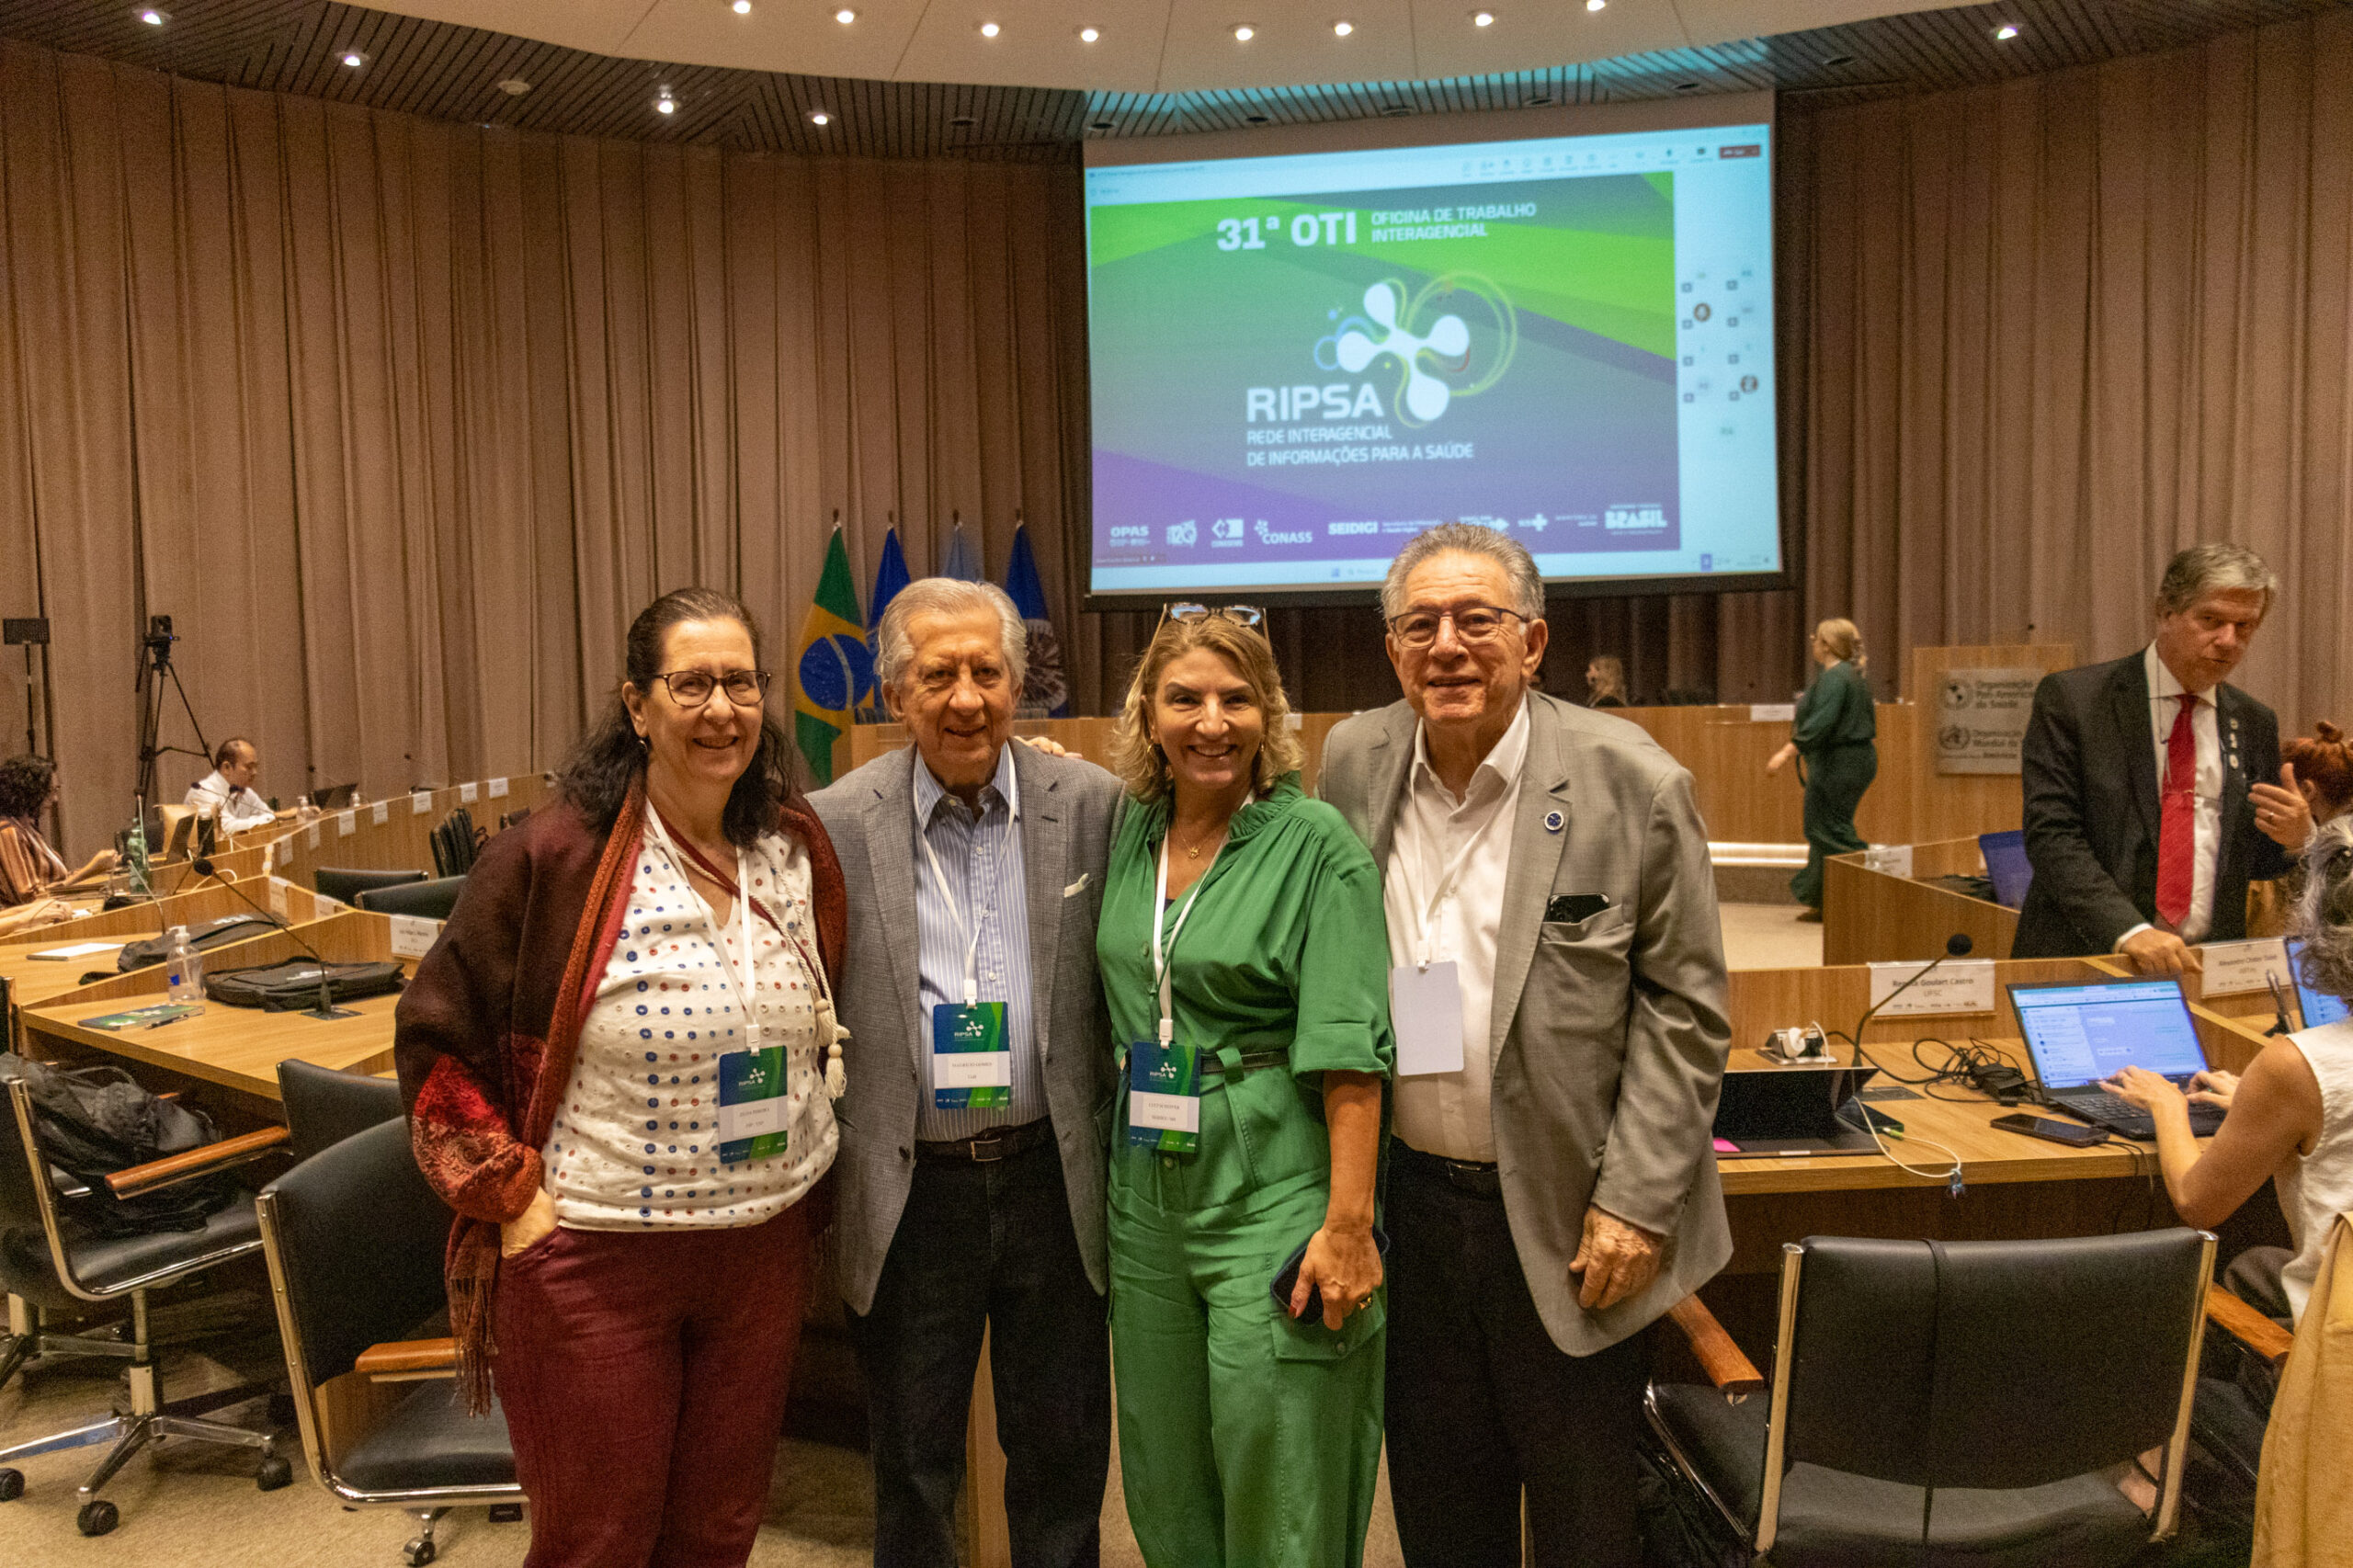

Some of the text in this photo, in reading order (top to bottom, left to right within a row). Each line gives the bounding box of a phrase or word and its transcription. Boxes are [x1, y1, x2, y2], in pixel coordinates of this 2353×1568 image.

[1371, 202, 1537, 226] OFICINA DE TRABALHO
[1217, 211, 1358, 251] 31ª OTI
[1371, 222, 1488, 243] INTERAGENCIAL
[1247, 382, 1384, 422] RIPSA
[1247, 425, 1392, 445] REDE INTERAGENCIAL
[1247, 441, 1473, 467] DE INFORMAÇÕES PARA A SAÚDE
[1109, 526, 1149, 537] OPAS
[1262, 531, 1313, 544] CONASS
[1328, 521, 1378, 535] SEIDIGI
